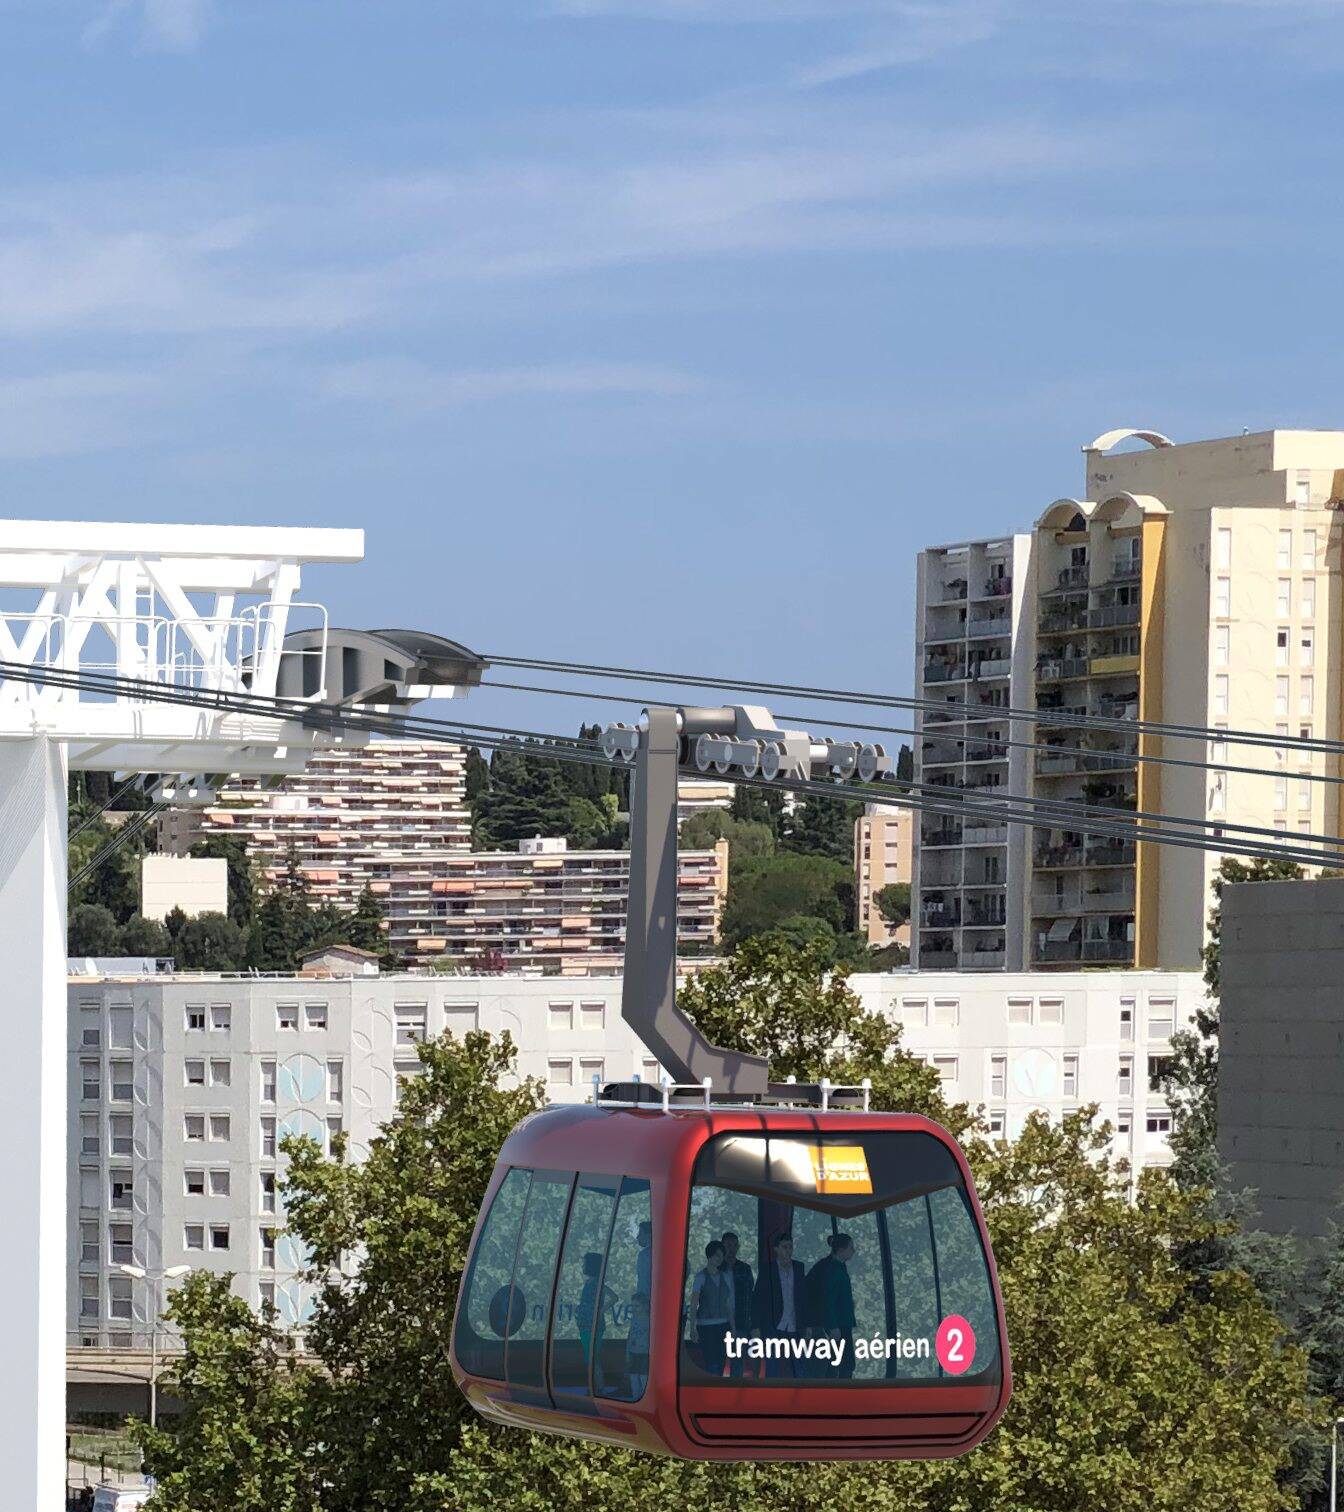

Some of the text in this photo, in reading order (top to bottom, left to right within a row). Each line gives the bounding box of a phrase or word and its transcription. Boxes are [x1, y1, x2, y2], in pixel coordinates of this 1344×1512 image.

[724, 1328, 964, 1366] tramway aérien 2
